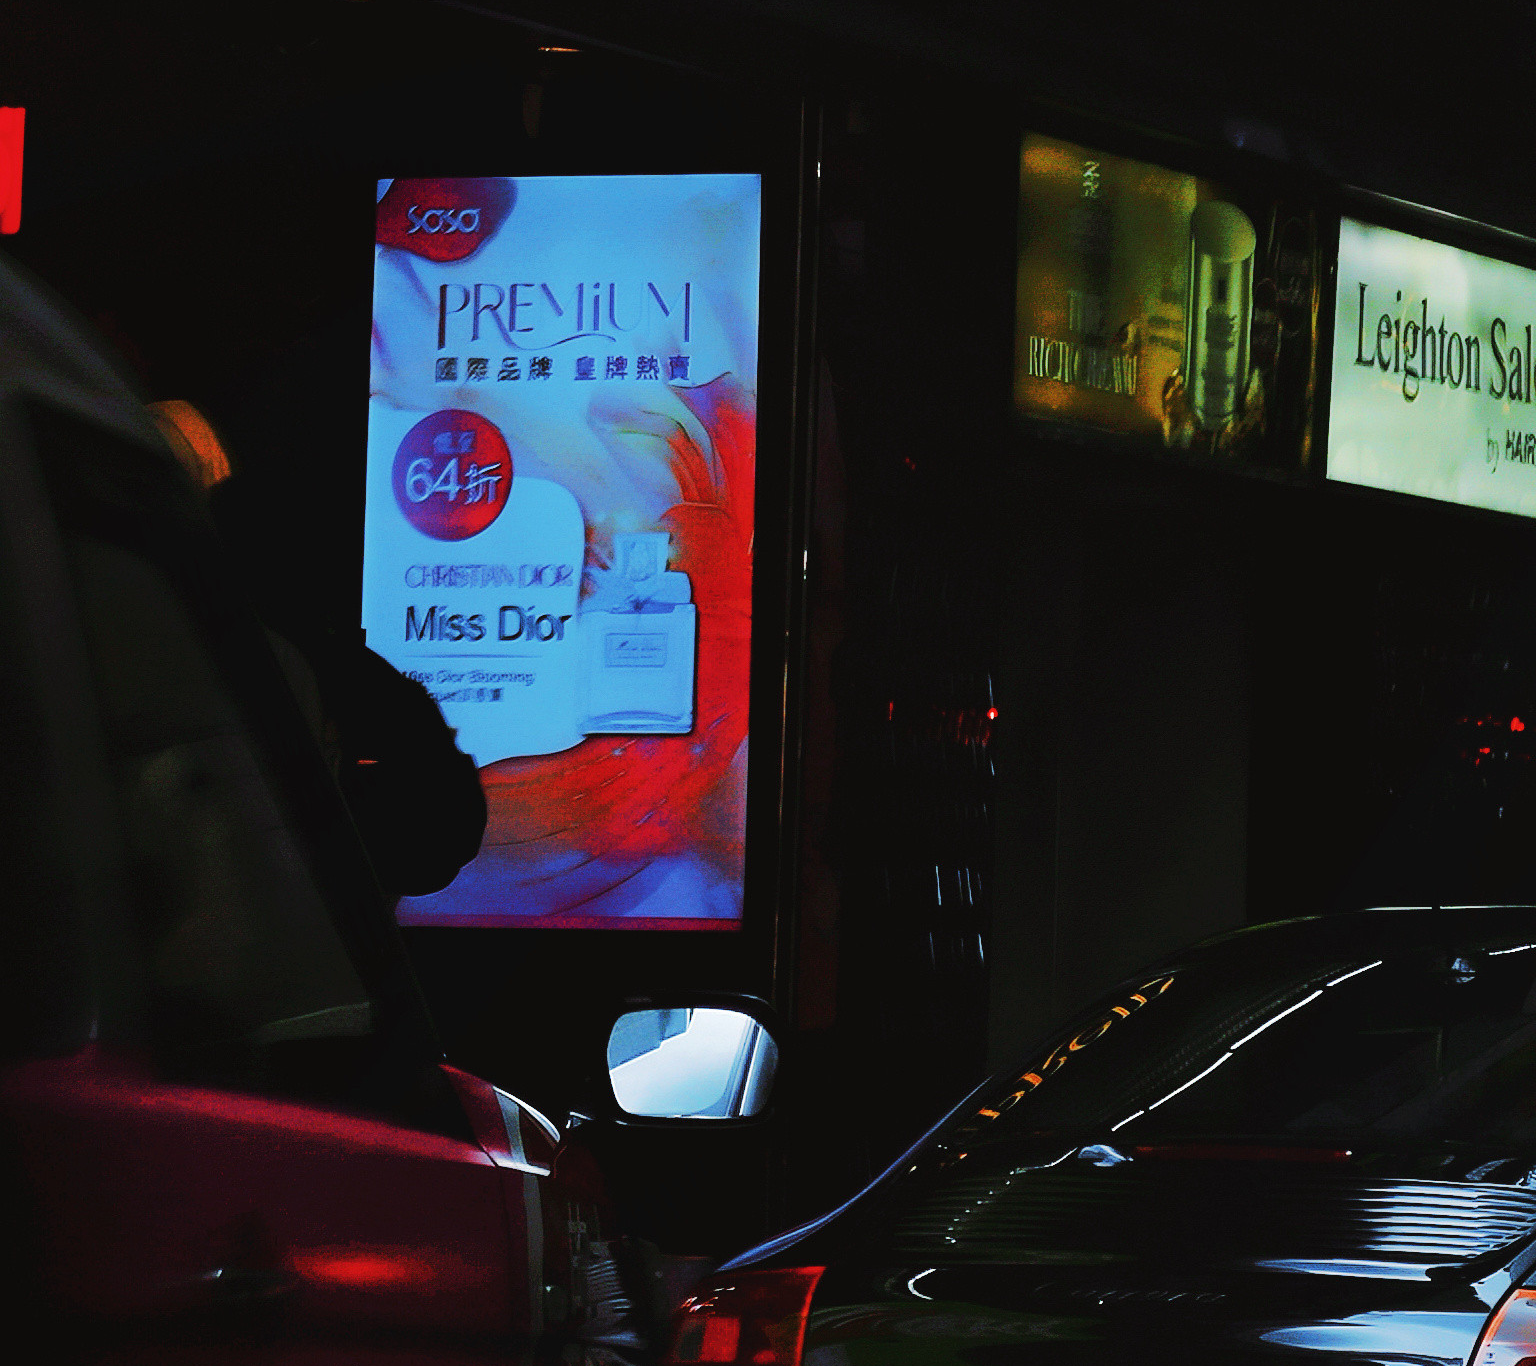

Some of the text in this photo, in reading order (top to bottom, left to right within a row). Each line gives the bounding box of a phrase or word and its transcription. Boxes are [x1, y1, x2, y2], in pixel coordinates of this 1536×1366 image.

[1354, 283, 1481, 402] Leighton
[519, 564, 574, 589] DIOR
[405, 605, 573, 642] Miss Dior
